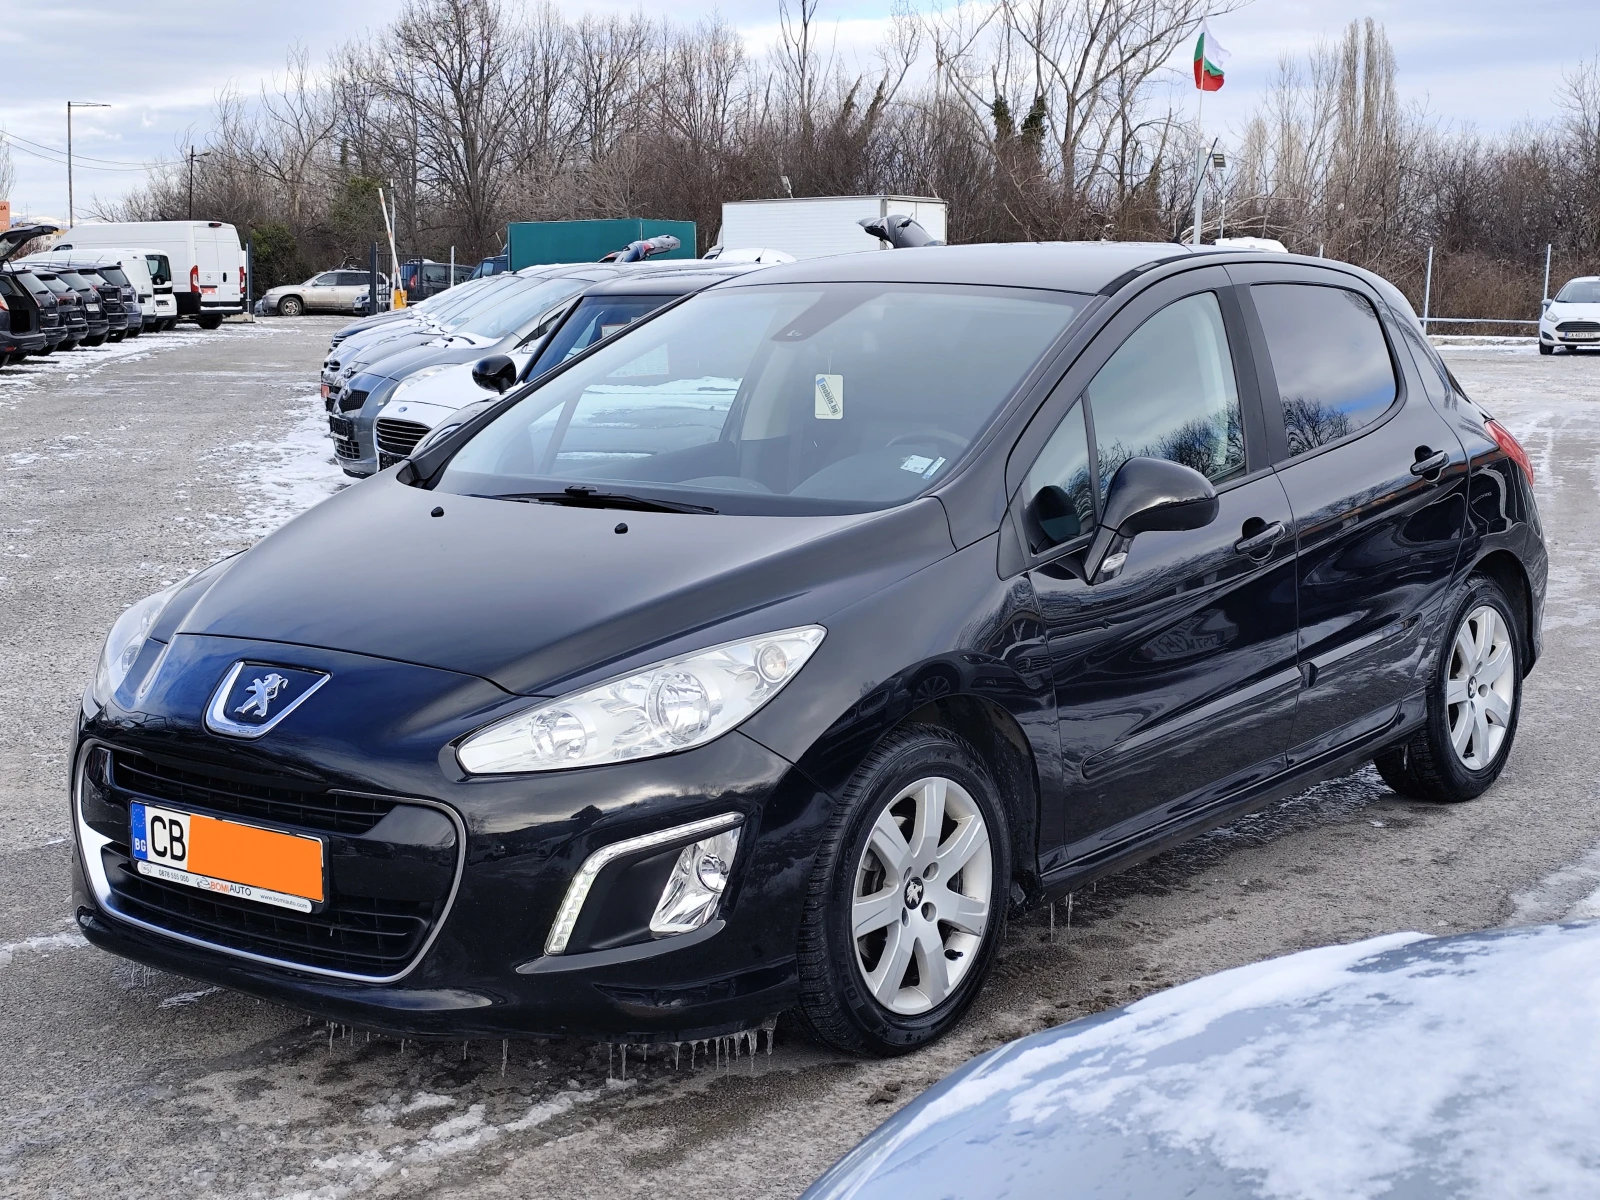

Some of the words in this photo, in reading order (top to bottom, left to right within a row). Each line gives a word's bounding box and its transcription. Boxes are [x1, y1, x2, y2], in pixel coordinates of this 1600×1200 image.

[820, 383, 839, 414] mobile.bg
[134, 838, 147, 852] BG
[150, 815, 187, 862] CB
[158, 869, 170, 878] 0878
[170, 872, 179, 880] 555
[210, 881, 252, 896] BOMIAUTO
[260, 894, 308, 909] www.bomiauto.com
